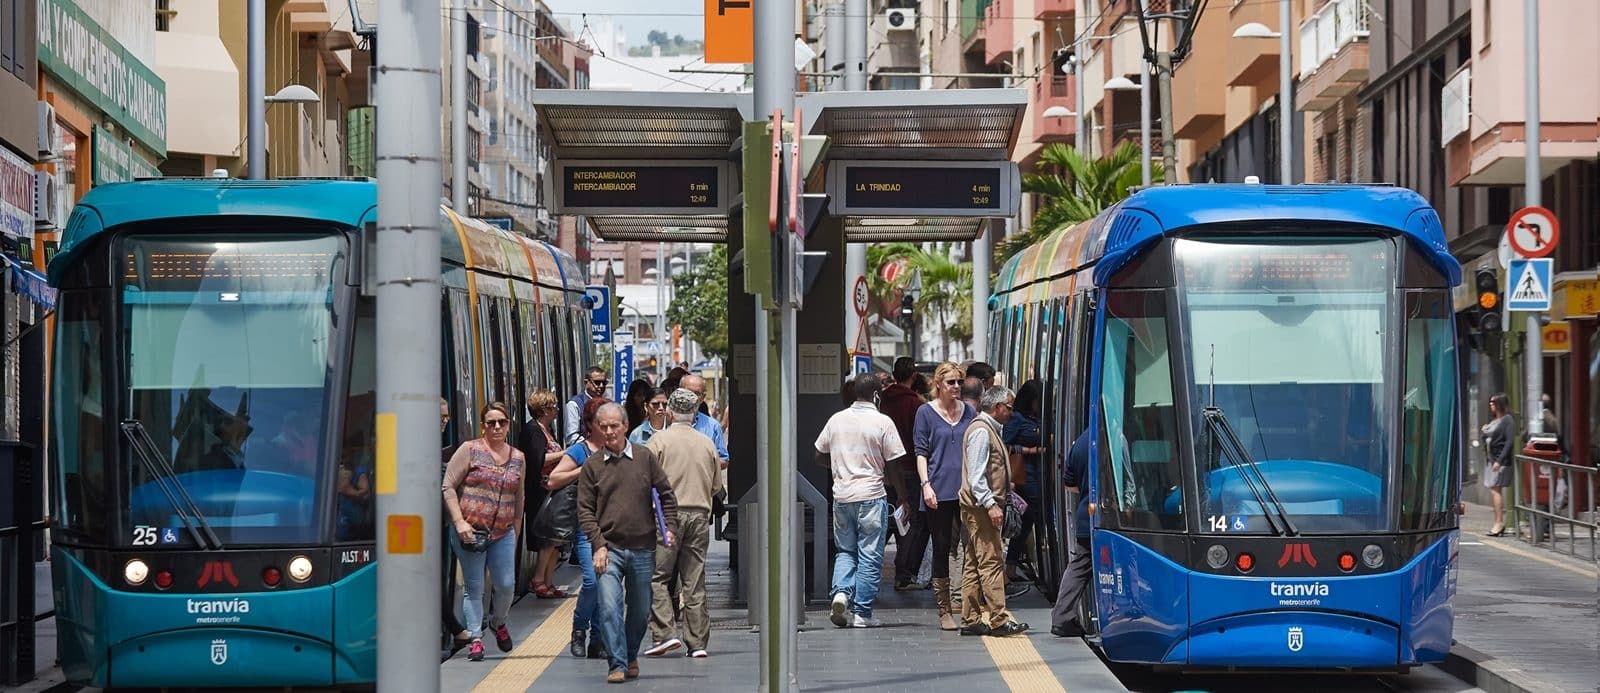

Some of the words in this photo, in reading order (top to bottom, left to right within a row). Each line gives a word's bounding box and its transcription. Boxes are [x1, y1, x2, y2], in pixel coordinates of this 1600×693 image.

[53, 3, 61, 58] Y
[62, 11, 127, 110] COMPLEMENTOS
[128, 67, 165, 140] CANARIAS
[573, 171, 637, 180] INTERCAMBIADOR
[573, 183, 637, 191] INTERCAMBIADOR
[696, 182, 709, 191] min
[855, 183, 866, 191] LA
[869, 183, 901, 191] TRINIDAD
[971, 184, 977, 192] 4
[978, 184, 991, 192] min
[690, 195, 707, 203] 12:49
[971, 196, 989, 204] 12:49
[1208, 515, 1227, 532] 14
[132, 527, 157, 545] 25
[341, 550, 370, 563] ALSTOM
[196, 616, 241, 624] metrotenerife
